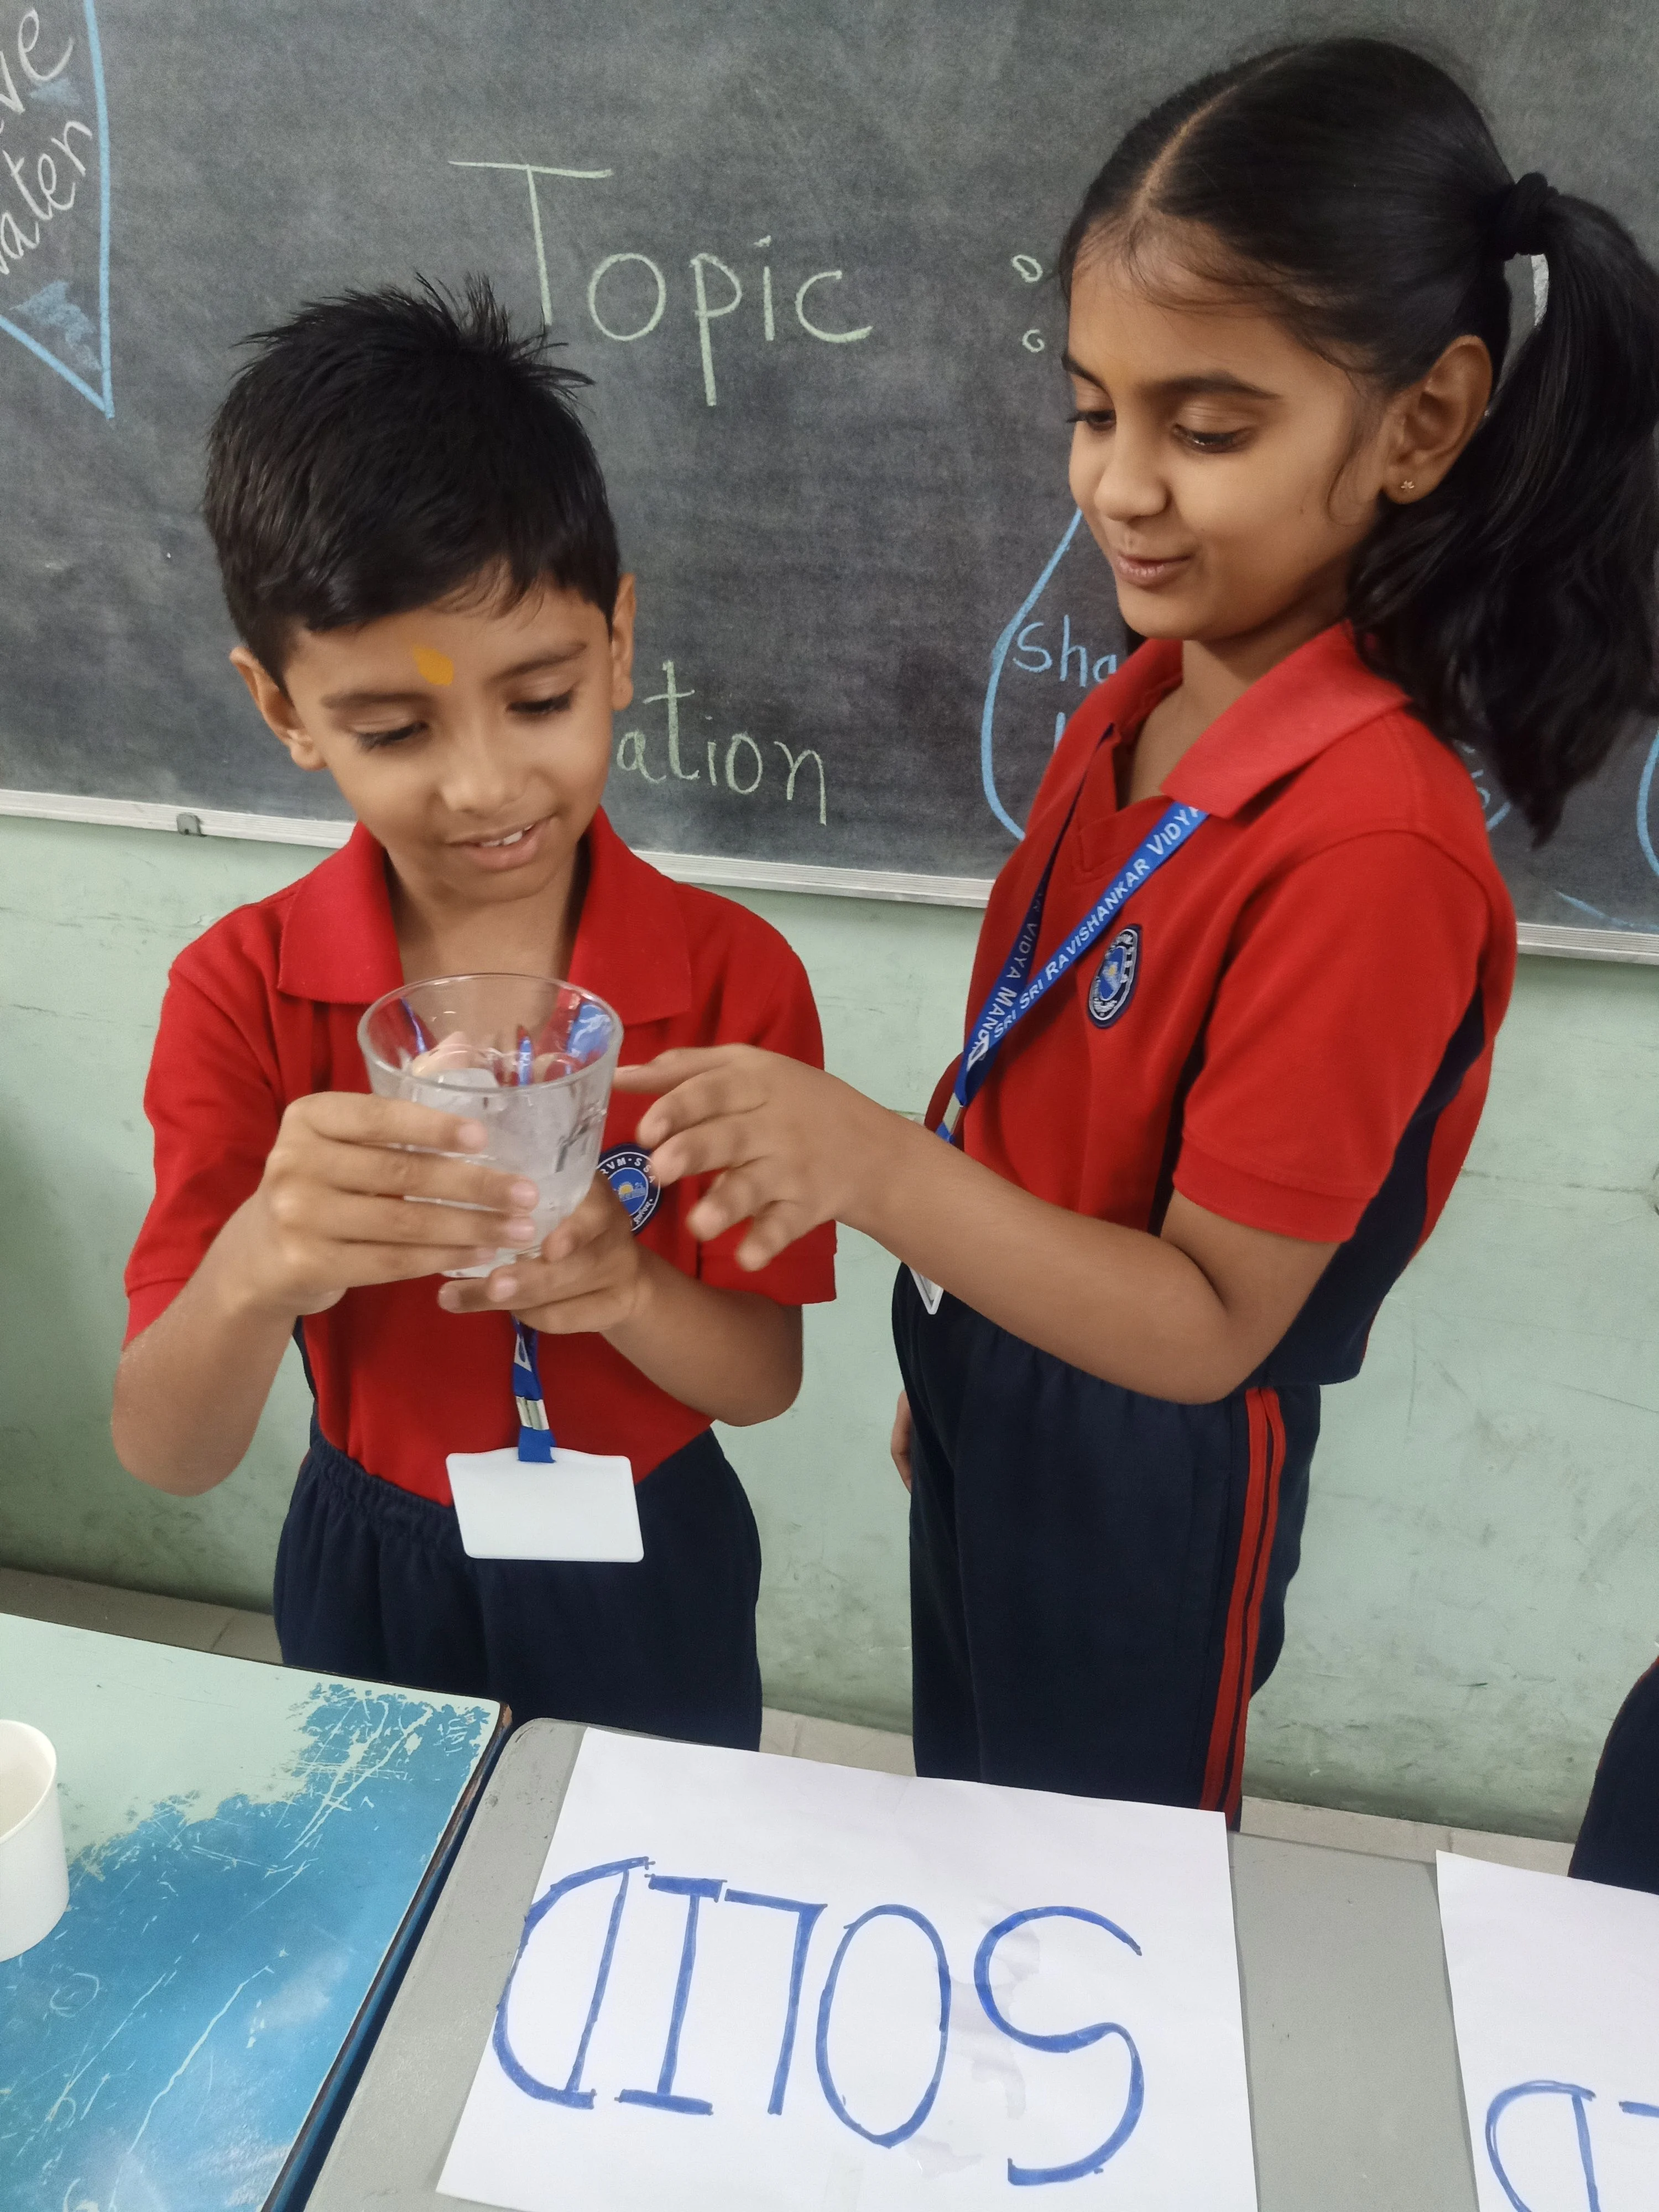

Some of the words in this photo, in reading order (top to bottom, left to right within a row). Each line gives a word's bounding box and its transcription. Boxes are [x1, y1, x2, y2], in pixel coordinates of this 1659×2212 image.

[0, 121, 93, 275] ater
[448, 160, 874, 406] Topic
[616, 660, 827, 826] ation
[972, 986, 1018, 1050] MAND
[994, 1009, 1016, 1038] SRI
[1019, 979, 1044, 1010] SRI
[1045, 858, 1150, 981] RAVISHANKAR
[1006, 922, 1038, 979] VIDYA
[492, 1855, 1145, 2187] SOLID
